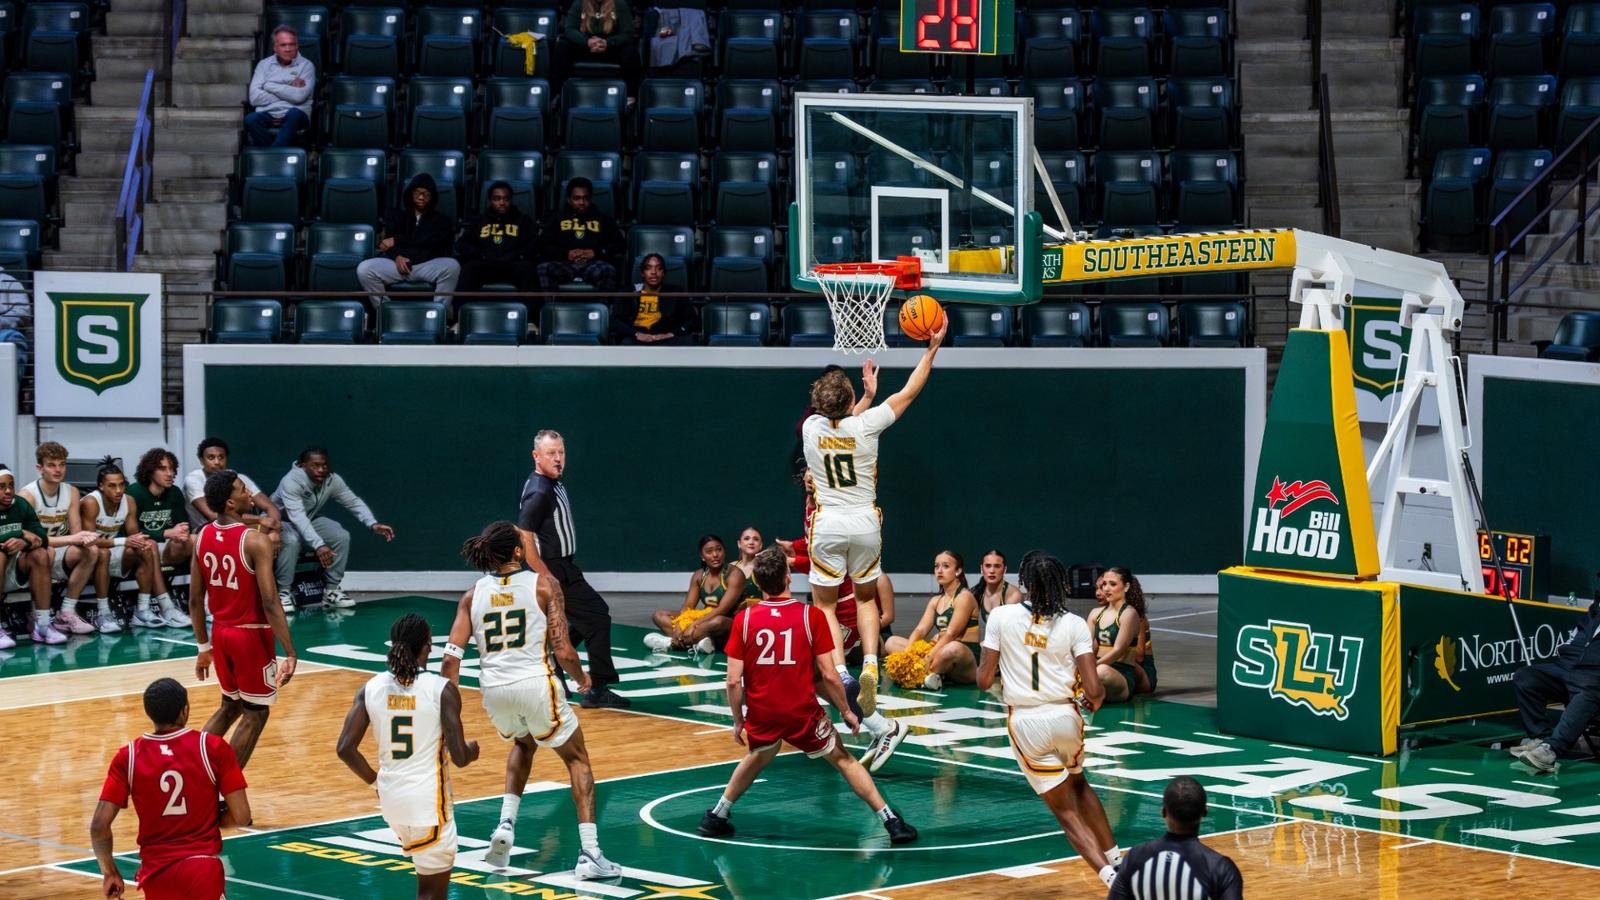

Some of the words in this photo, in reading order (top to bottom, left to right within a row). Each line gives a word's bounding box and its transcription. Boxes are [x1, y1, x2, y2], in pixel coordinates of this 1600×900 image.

[917, 0, 977, 48] 28
[480, 223, 519, 238] SLU
[560, 218, 600, 232] SLU
[1083, 237, 1276, 273] SOUTHEASTERN
[77, 314, 120, 365] S
[1363, 319, 1403, 369] S
[823, 453, 858, 488] 10
[1251, 507, 1341, 561] HOOD
[1309, 510, 1340, 533] Bill
[203, 551, 239, 591] 22
[482, 608, 527, 653] 23
[755, 627, 797, 666] 21
[1031, 651, 1040, 692] 1
[1232, 620, 1364, 698] SLU
[391, 716, 414, 760] 5
[159, 769, 188, 817] 2
